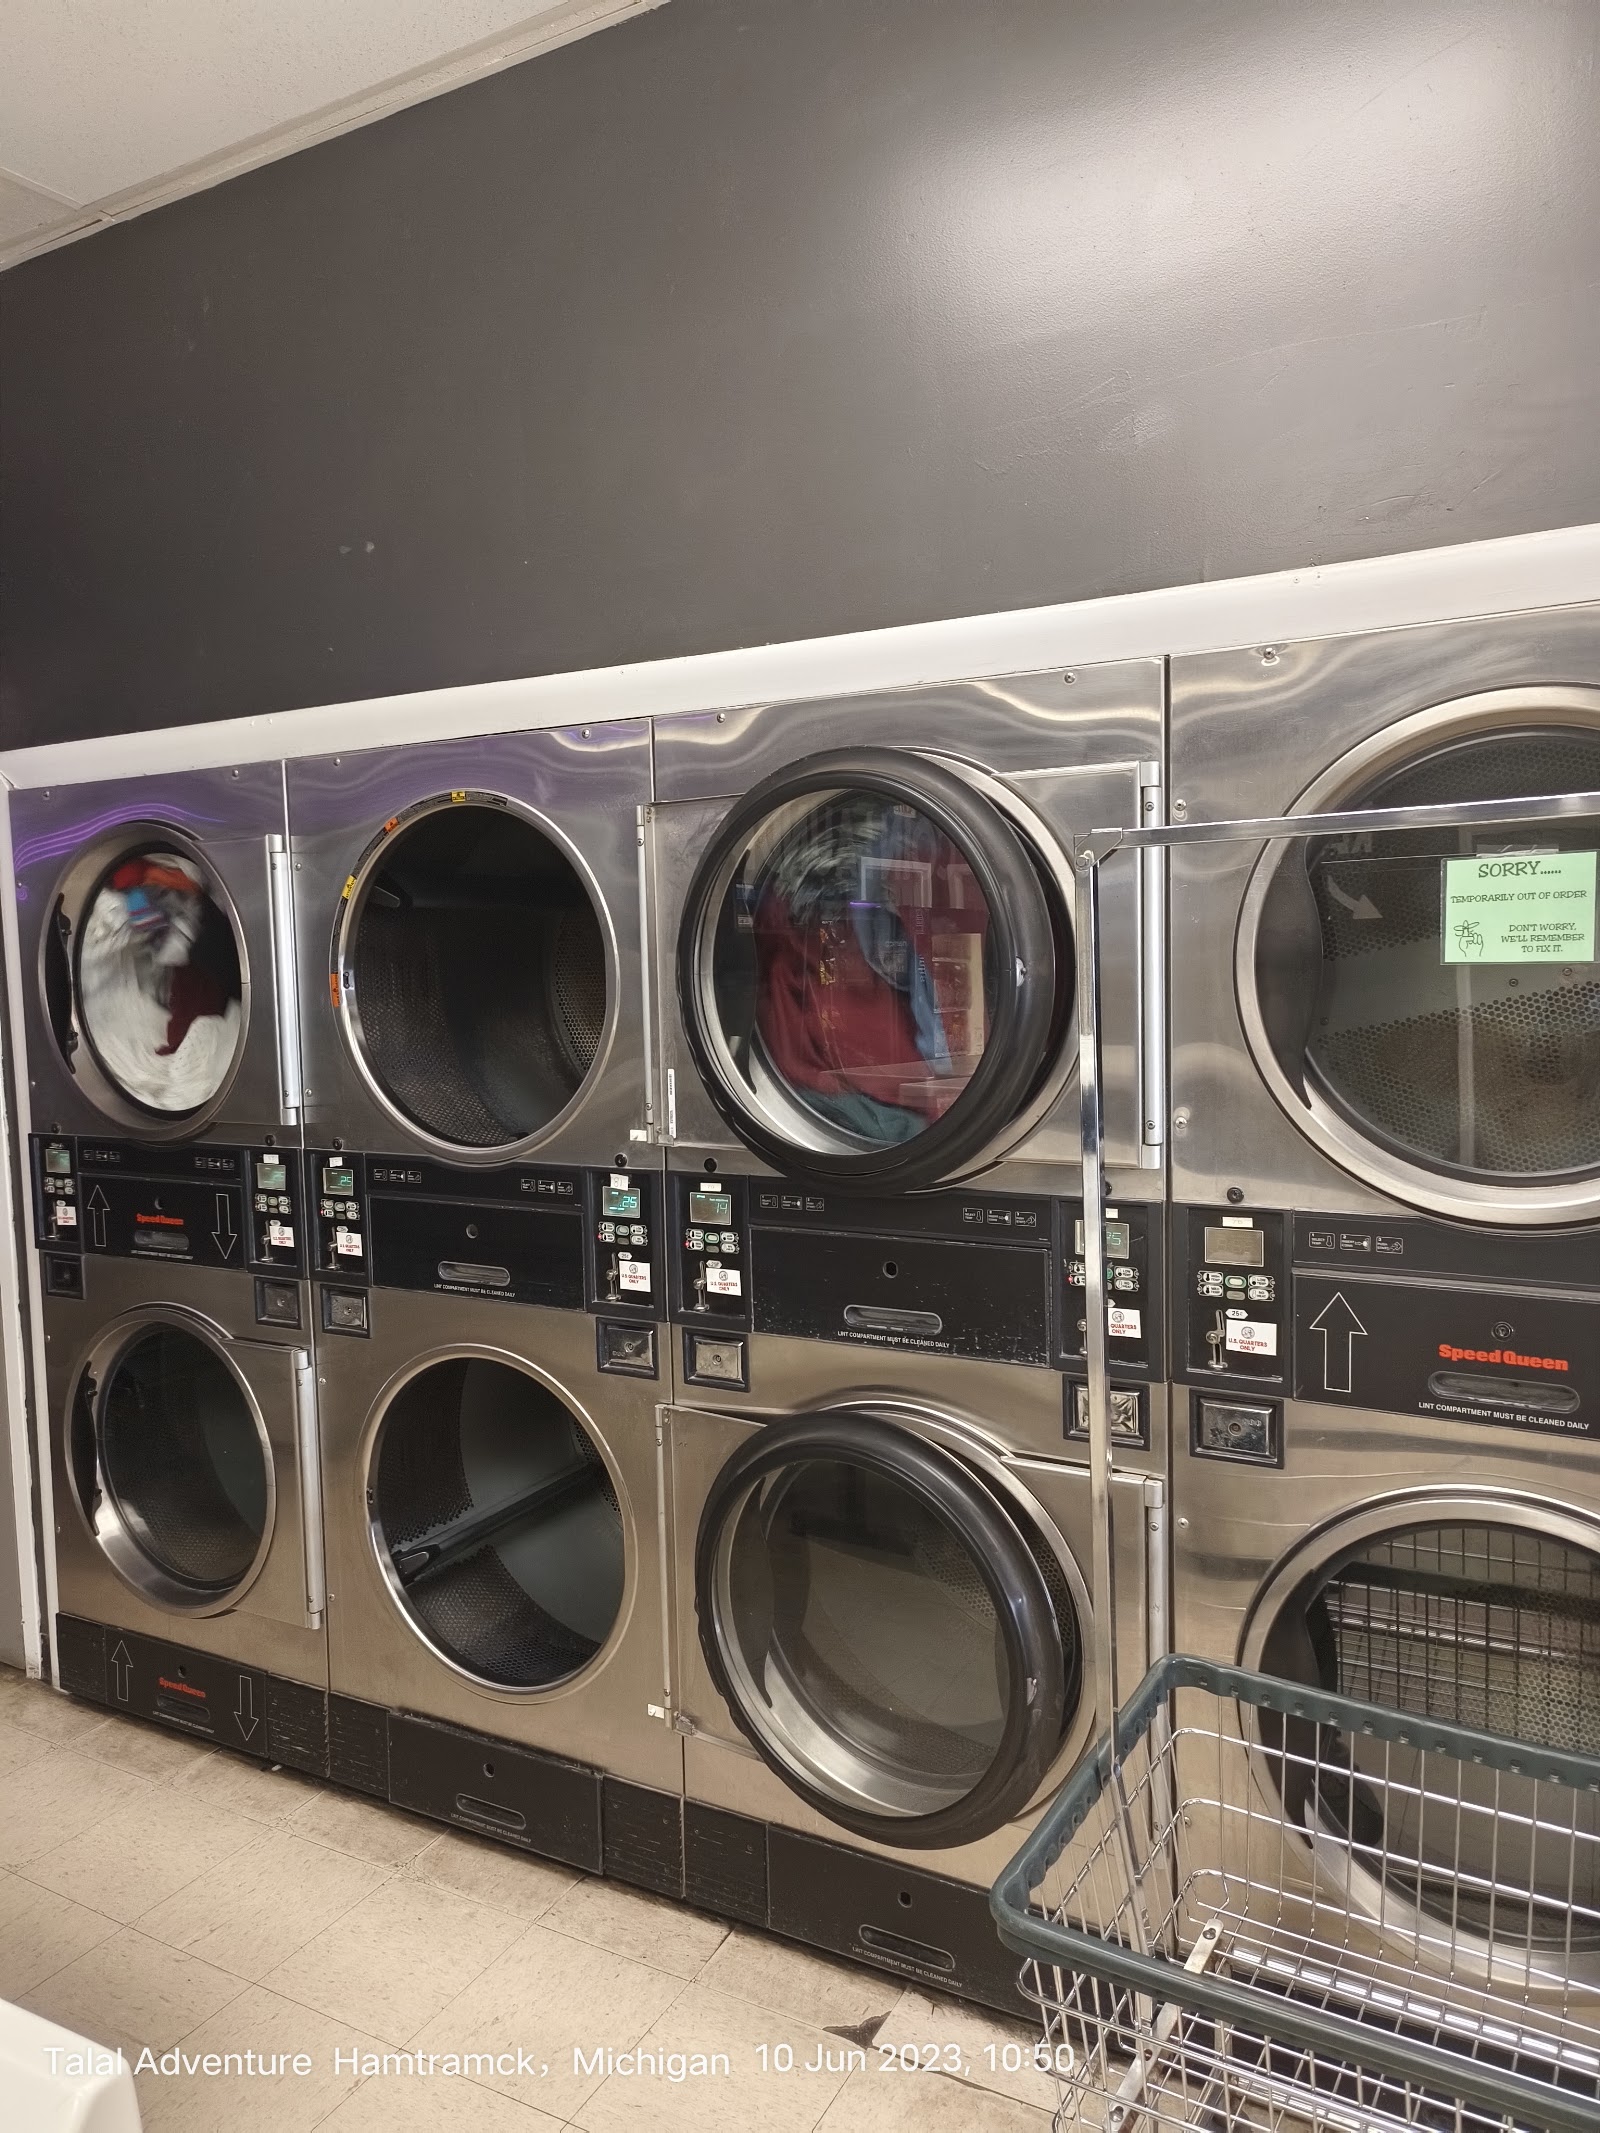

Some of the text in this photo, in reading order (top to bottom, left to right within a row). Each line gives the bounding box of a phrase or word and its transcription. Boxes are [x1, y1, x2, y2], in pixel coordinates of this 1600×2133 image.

[1451, 890, 1587, 903] TEMPORARILY OUT OF ORDER
[1509, 924, 1537, 932] DON'T
[1501, 934, 1585, 943] WE'LL REMEMBER
[1521, 945, 1533, 953] TO
[849, 1331, 886, 1341] COMPARTMENT
[910, 1338, 934, 1347] CLEANED
[1238, 1339, 1268, 1348] QUARTERS
[1438, 1343, 1569, 1371] Speed Queen
[1435, 1403, 1492, 1418] COMPARTMENT
[1493, 1411, 1514, 1420] MUST
[1516, 1414, 1527, 1422] BE
[1528, 1415, 1565, 1427] CLEANED
[1567, 1421, 1590, 1430] DAILY
